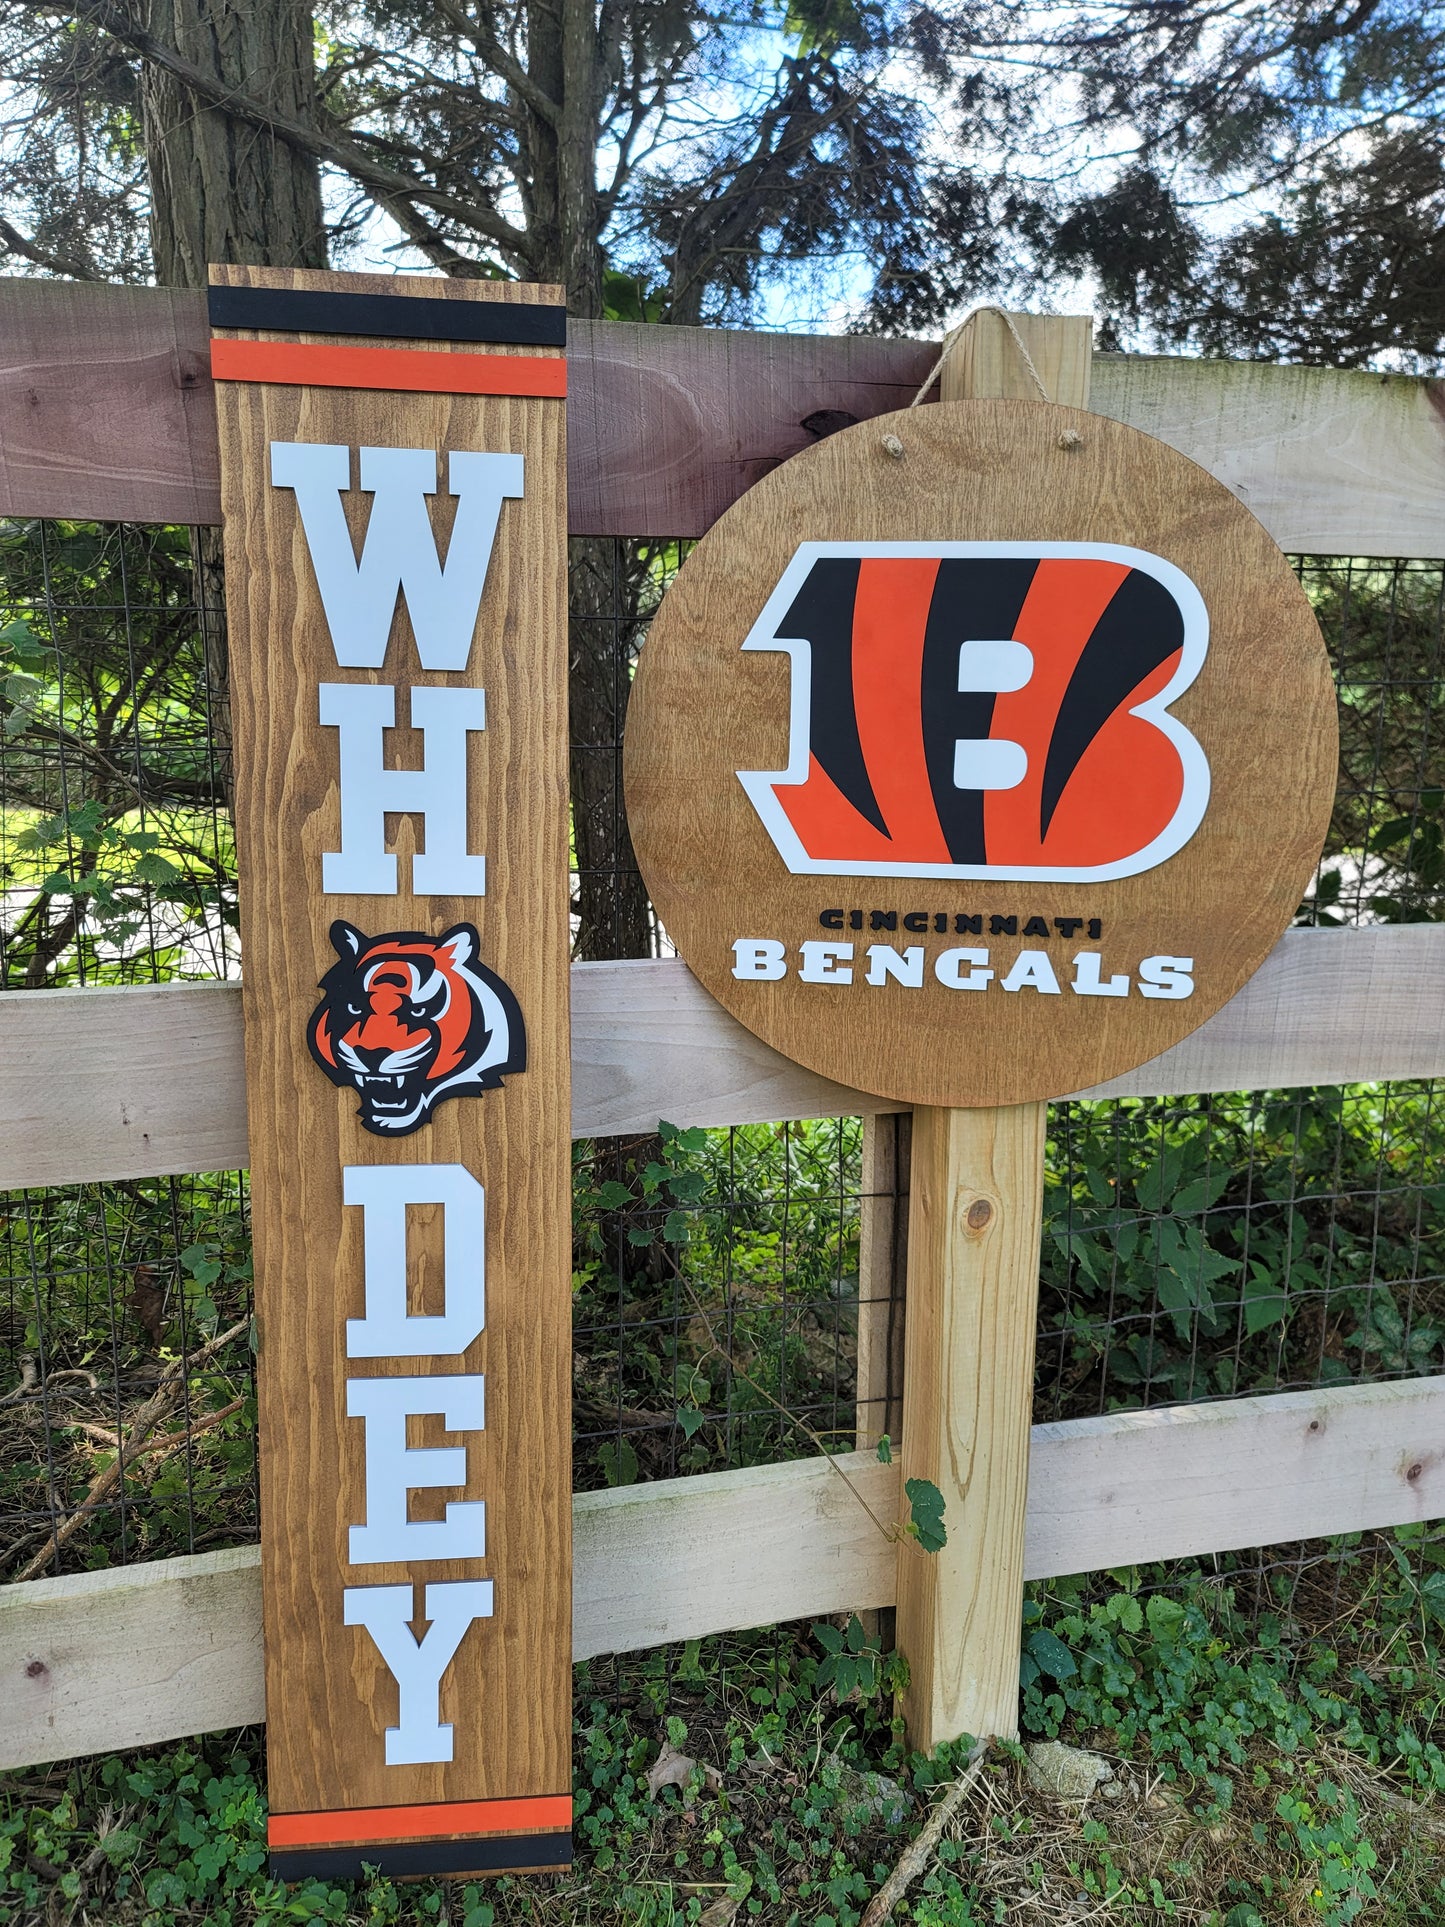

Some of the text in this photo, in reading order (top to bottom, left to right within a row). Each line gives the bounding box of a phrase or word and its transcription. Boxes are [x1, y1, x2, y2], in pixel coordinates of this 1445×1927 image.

[736, 541, 1211, 882] B
[731, 938, 1196, 999] BENGALS
[819, 908, 1102, 939] CINCINNATI
[342, 1162, 493, 1764] DEY
